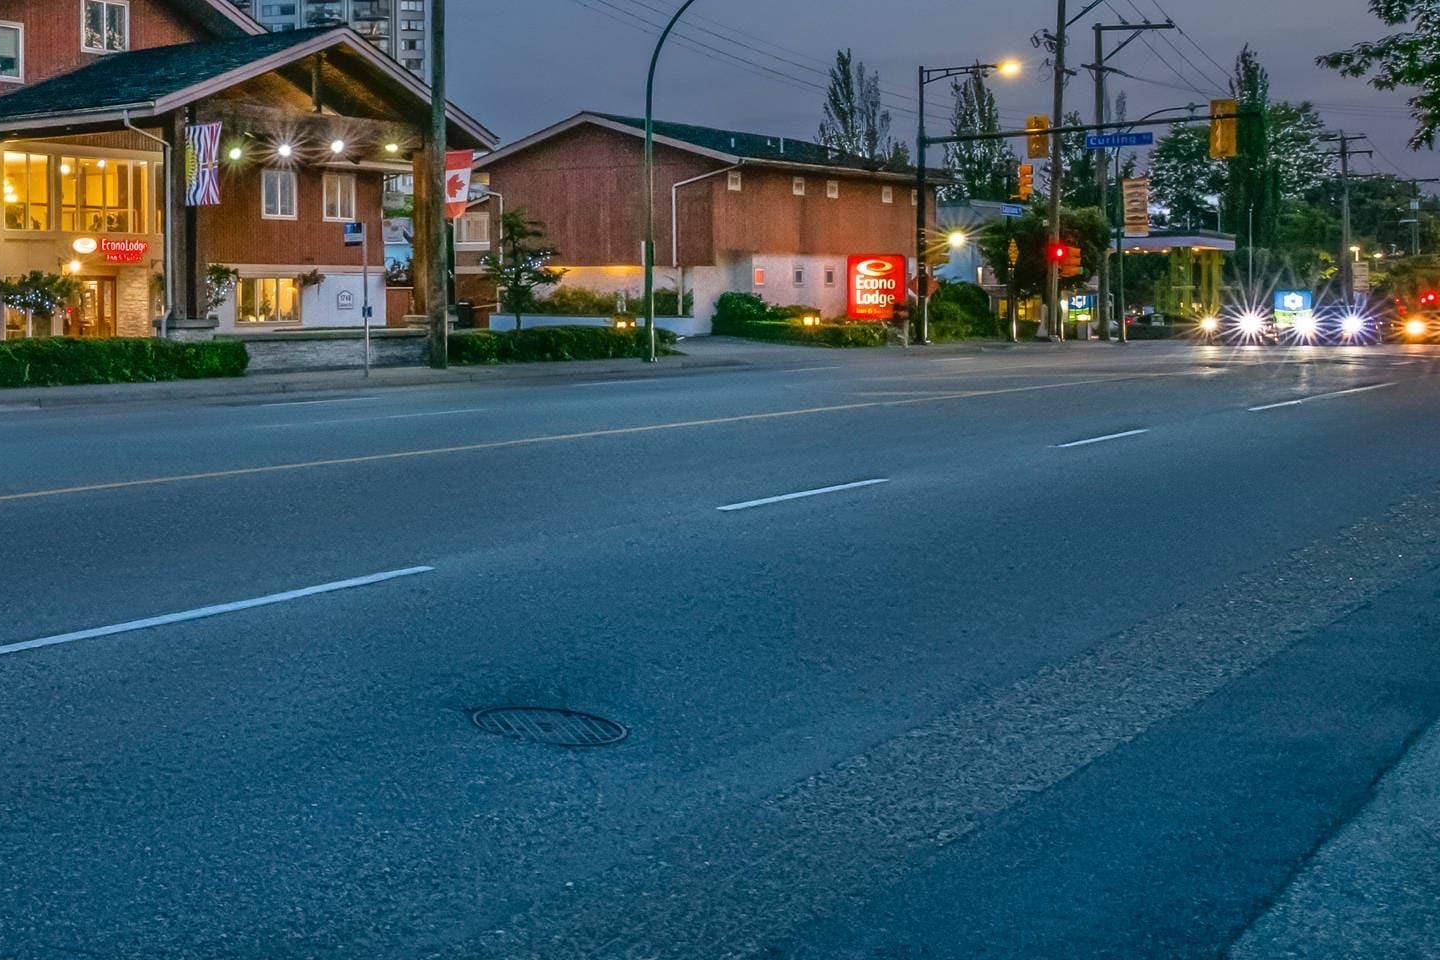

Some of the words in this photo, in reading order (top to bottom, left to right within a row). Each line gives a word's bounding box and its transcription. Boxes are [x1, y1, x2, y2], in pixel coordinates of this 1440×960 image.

[1089, 135, 1137, 145] Curling
[855, 274, 896, 290] Econo
[855, 289, 896, 308] Lodge
